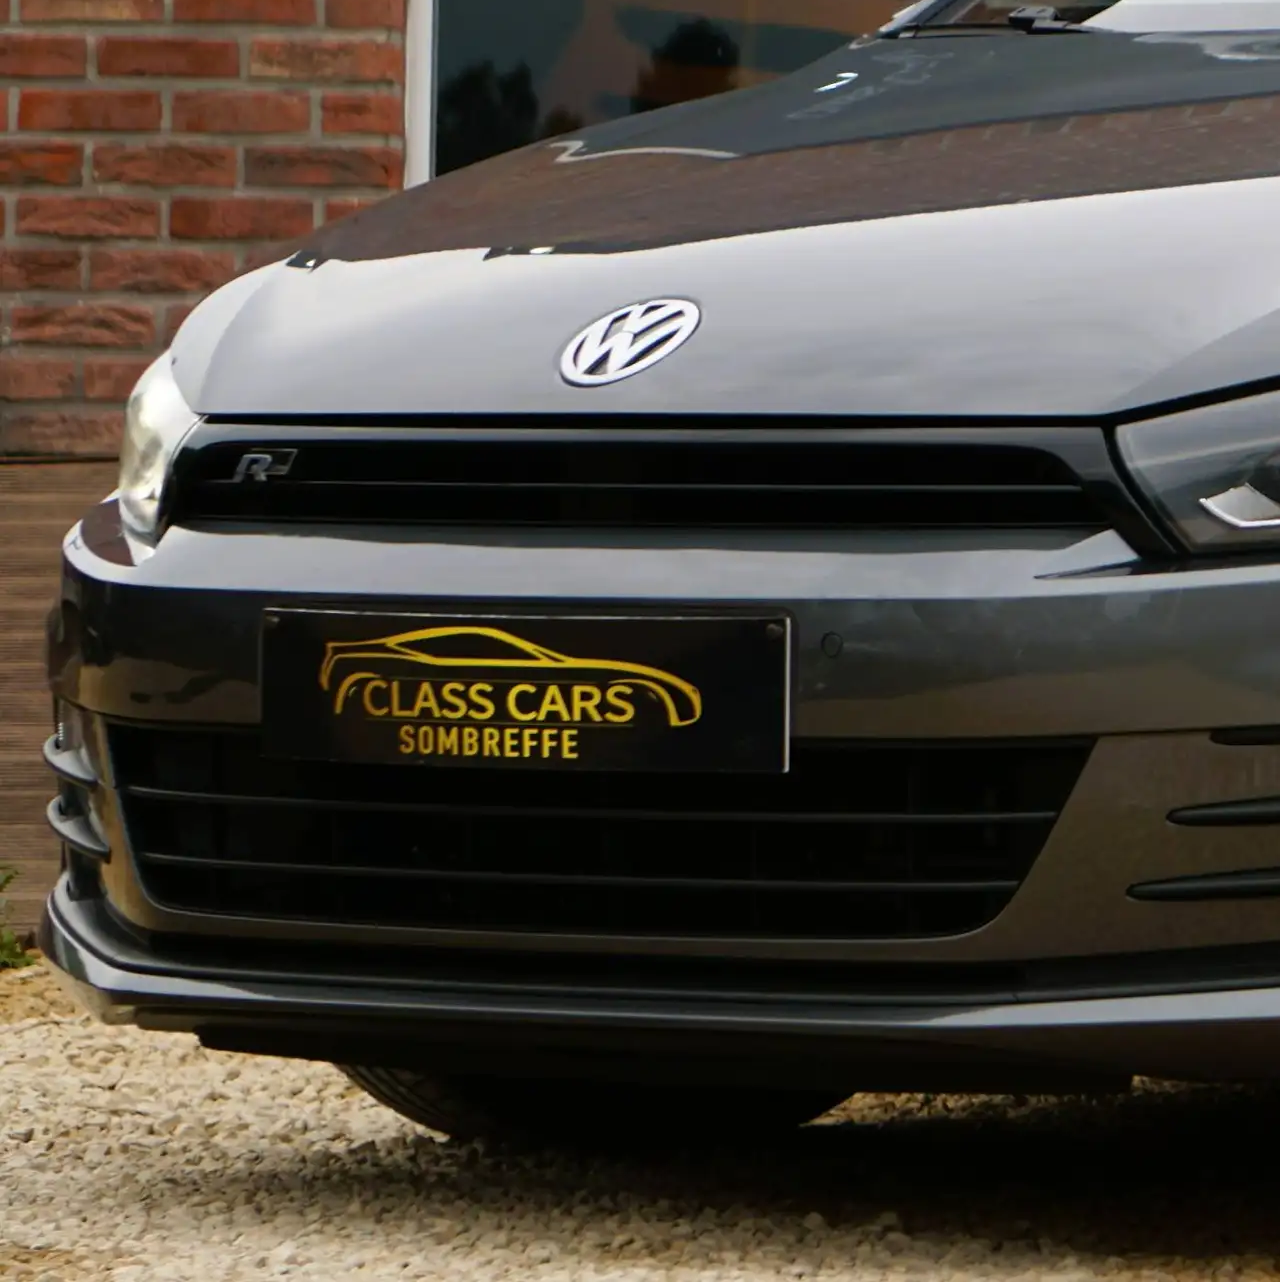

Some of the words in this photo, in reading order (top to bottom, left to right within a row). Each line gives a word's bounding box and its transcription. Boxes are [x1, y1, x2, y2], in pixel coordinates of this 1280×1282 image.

[363, 679, 496, 720] CLASS
[506, 682, 636, 723] CARS
[399, 724, 579, 759] SOMBREFFE
